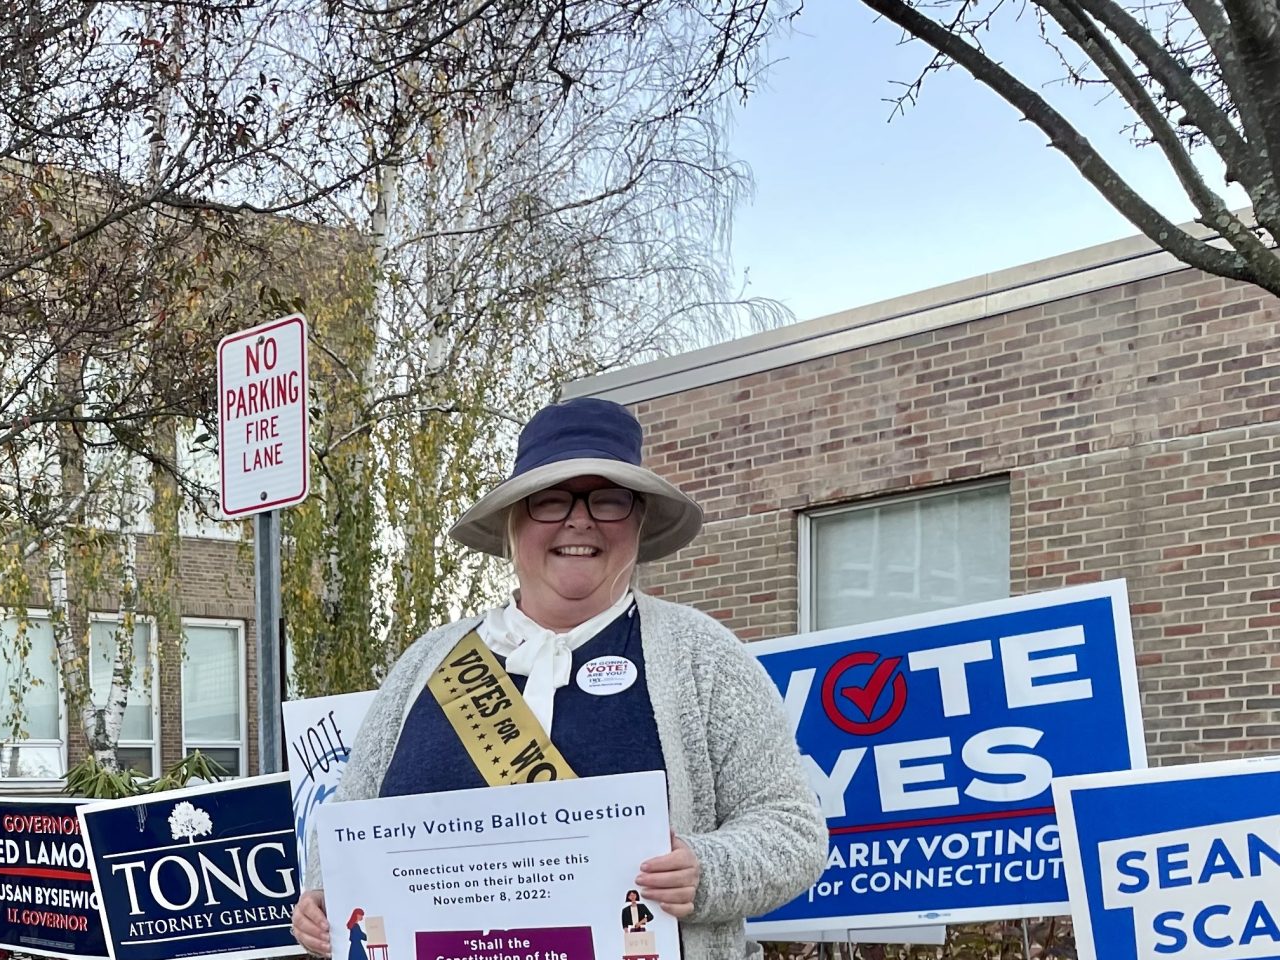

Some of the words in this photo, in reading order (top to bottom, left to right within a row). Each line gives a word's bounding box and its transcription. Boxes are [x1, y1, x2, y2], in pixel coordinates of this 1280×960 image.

[246, 337, 277, 377] NO
[226, 370, 299, 421] PARKING
[246, 416, 279, 444] FIRE
[243, 443, 283, 473] LANE
[587, 665, 628, 673] VOTE!
[450, 648, 513, 718] VOTES
[493, 717, 520, 745] FOR
[292, 710, 350, 782] VOTE
[800, 725, 1054, 819] YES
[335, 827, 366, 842] The
[373, 823, 416, 839] Early
[423, 818, 484, 833] Voting
[492, 811, 548, 829] Ballot
[555, 803, 646, 825] Question
[25, 840, 89, 869] LAMO
[825, 838, 910, 870] ARLY
[916, 824, 1061, 862] VOTING
[111, 842, 296, 916] TONG
[392, 864, 465, 877] Connecticut
[469, 860, 508, 871] voters
[512, 857, 535, 869] will
[539, 856, 561, 866] see
[565, 854, 590, 865] this
[850, 857, 1065, 894] CONNECTICUT
[409, 880, 460, 892] question
[464, 879, 479, 888] on
[484, 876, 513, 887] their
[518, 873, 555, 884] ballot
[559, 872, 575, 881] on
[433, 893, 495, 906] November
[500, 891, 511, 902] 8,
[515, 889, 551, 901] 2022:
[22, 909, 88, 932] GOVERNOR
[129, 912, 214, 937] ATTORNEY
[463, 938, 503, 951] "Shall
[508, 937, 531, 949] the
